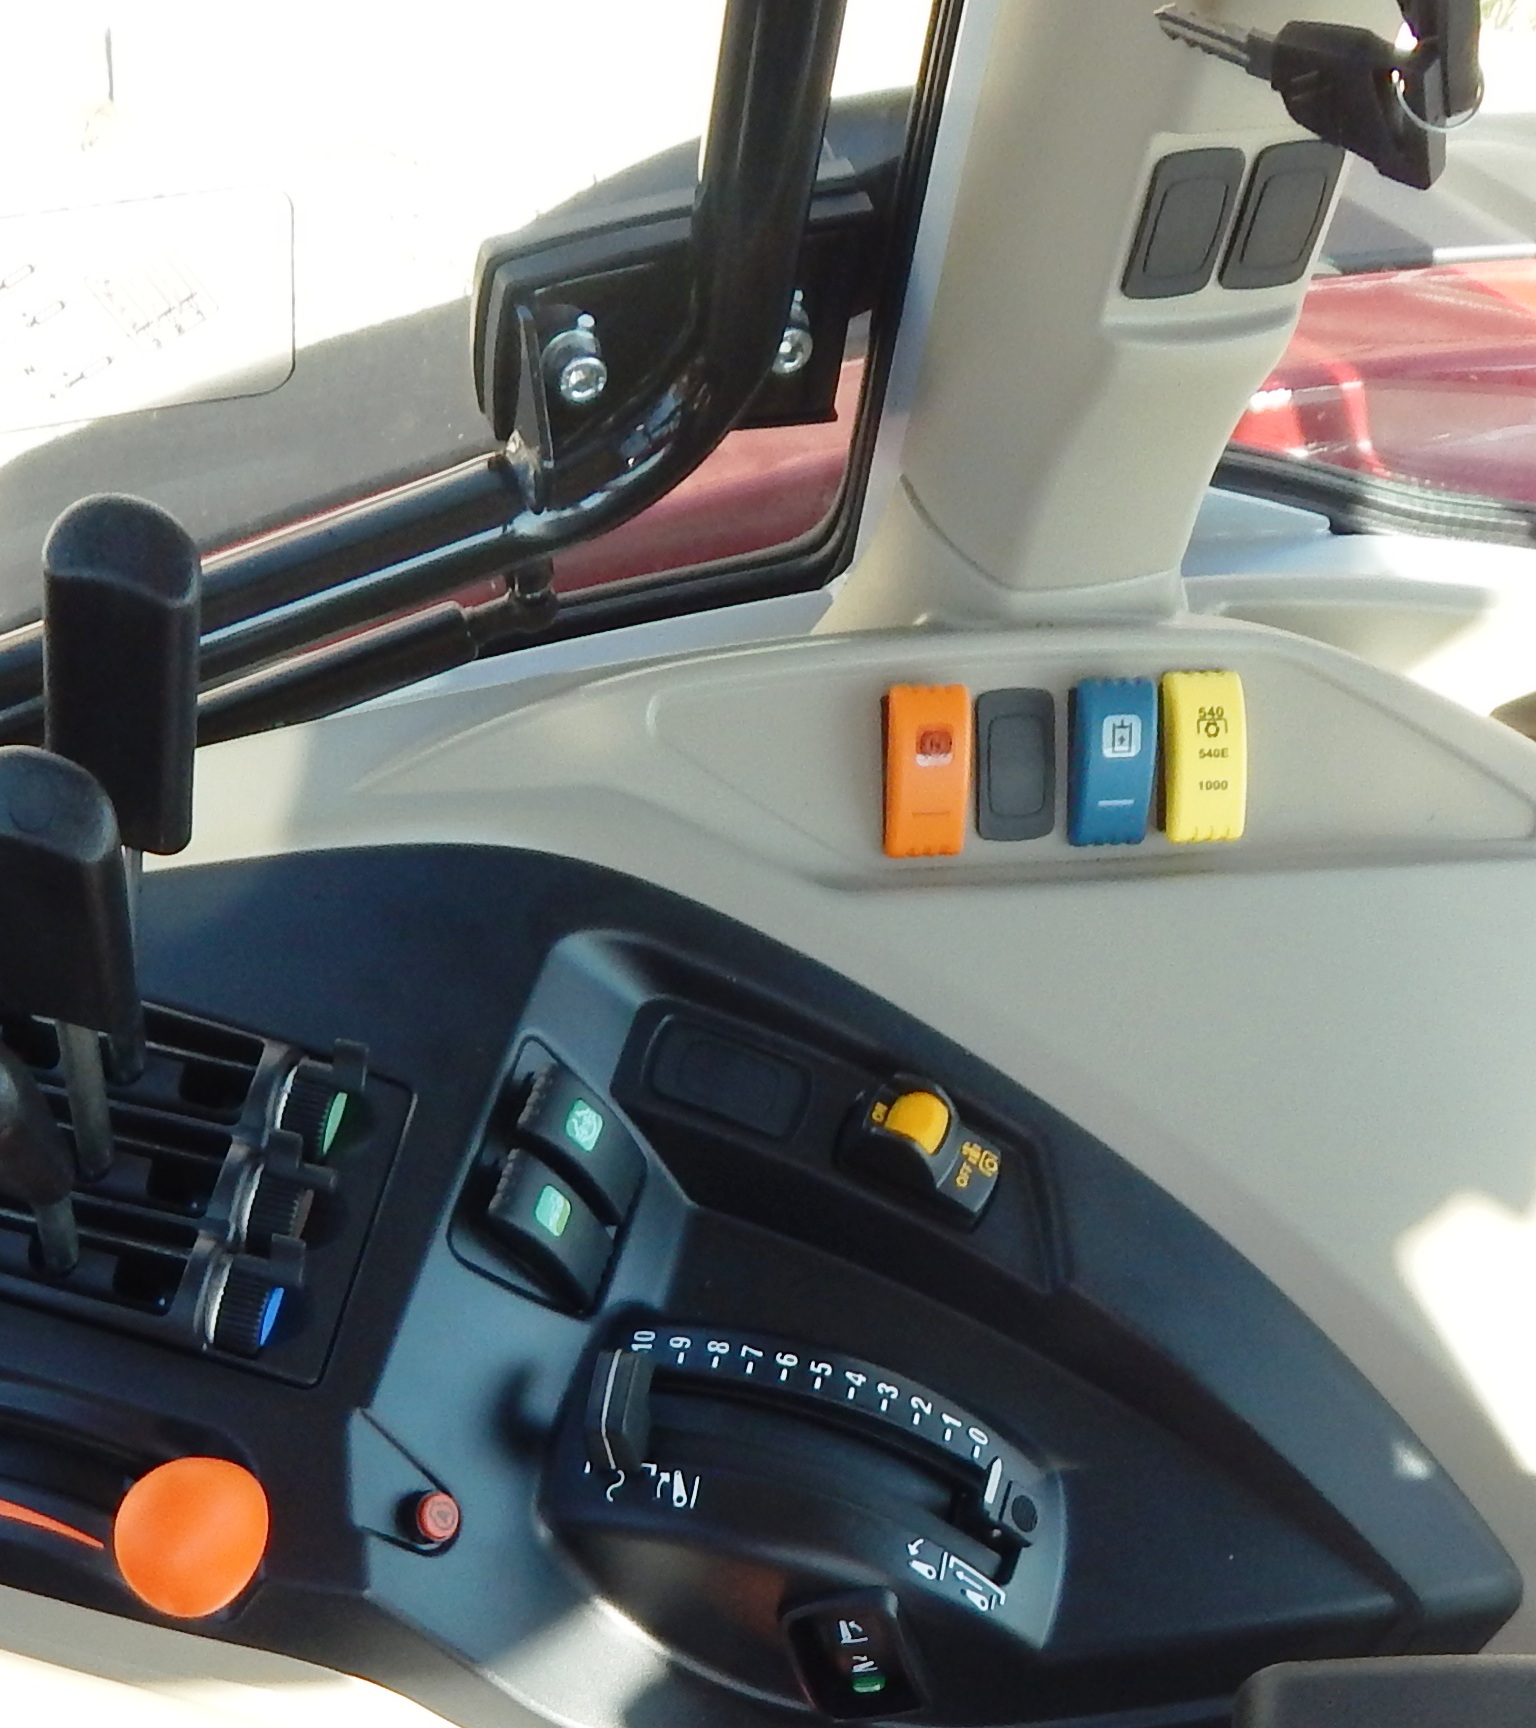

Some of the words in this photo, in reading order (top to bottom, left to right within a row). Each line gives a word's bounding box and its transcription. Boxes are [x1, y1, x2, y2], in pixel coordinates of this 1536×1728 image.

[1198, 705, 1225, 719] 540
[1198, 747, 1230, 759] 540E
[1198, 780, 1229, 791] 1000
[631, 1330, 656, 1351] 10
[669, 1336, 692, 1349] 9
[707, 1340, 730, 1355] 8
[740, 1344, 764, 1358] 7
[775, 1352, 799, 1367] 6
[809, 1360, 833, 1376] 5
[845, 1371, 867, 1387] 4
[876, 1382, 899, 1400] 3
[910, 1396, 933, 1415] 2
[941, 1412, 962, 1428] 1
[968, 1427, 989, 1446] 0
